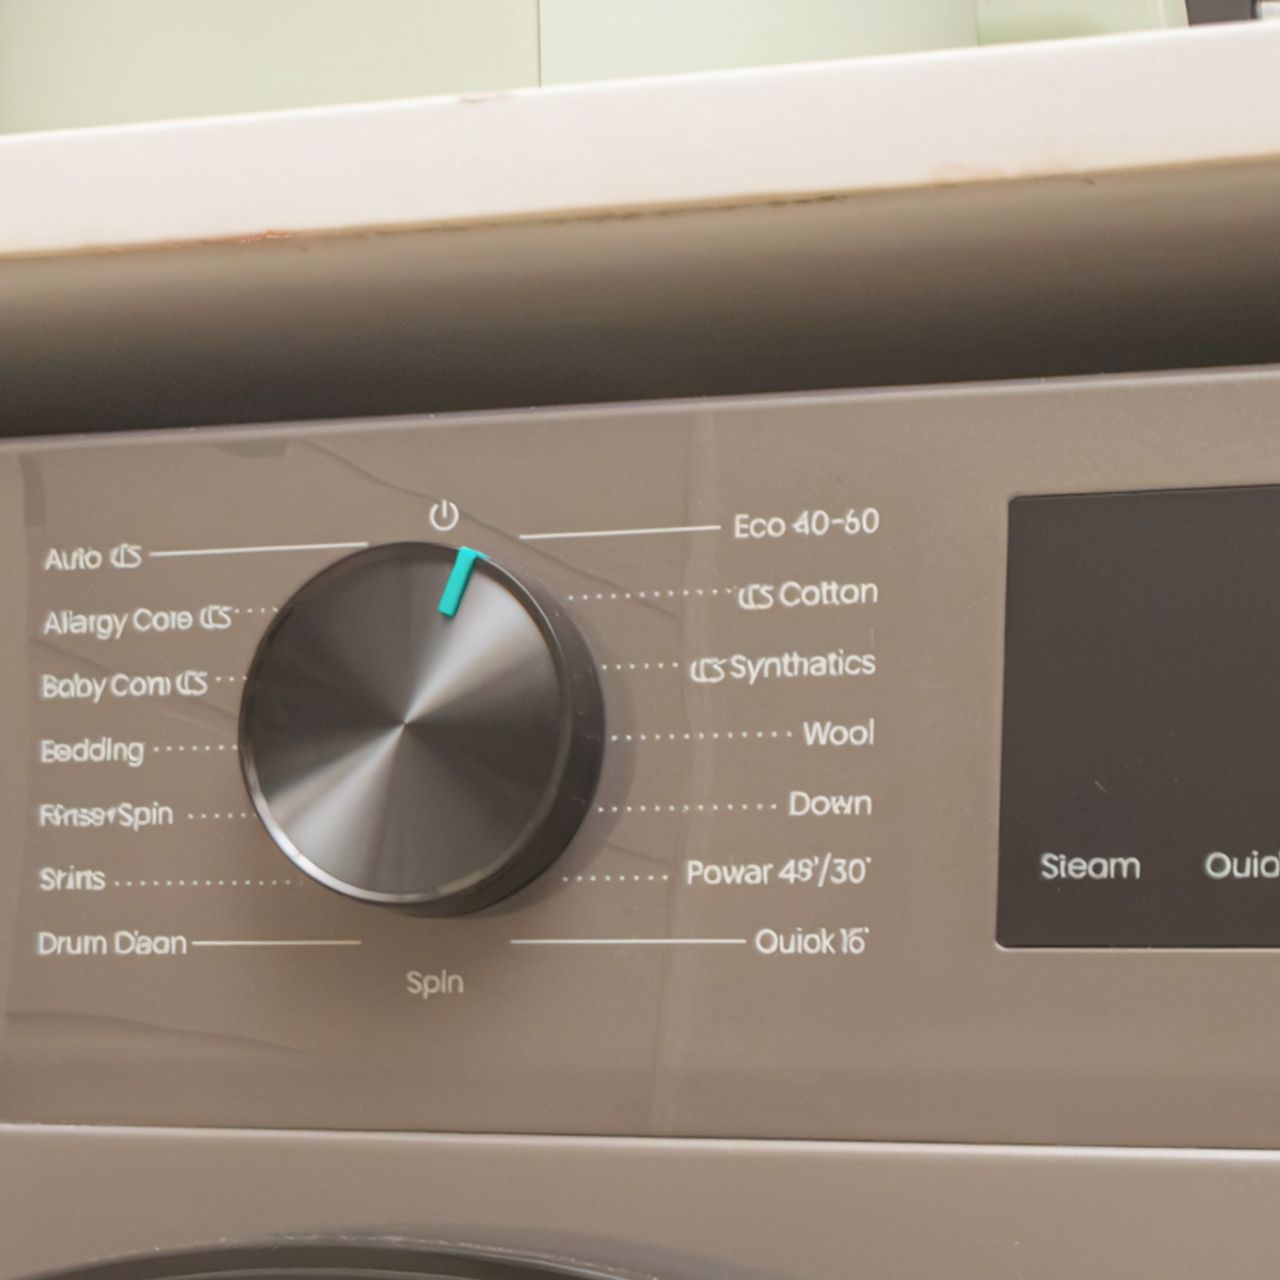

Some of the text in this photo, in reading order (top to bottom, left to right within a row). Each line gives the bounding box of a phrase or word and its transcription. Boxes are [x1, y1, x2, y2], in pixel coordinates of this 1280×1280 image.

[734, 507, 880, 539] Eco 40-60
[779, 581, 878, 607] Cotton
[803, 717, 875, 746] Wool
[789, 790, 872, 816] Down
[38, 931, 108, 955] Drum
